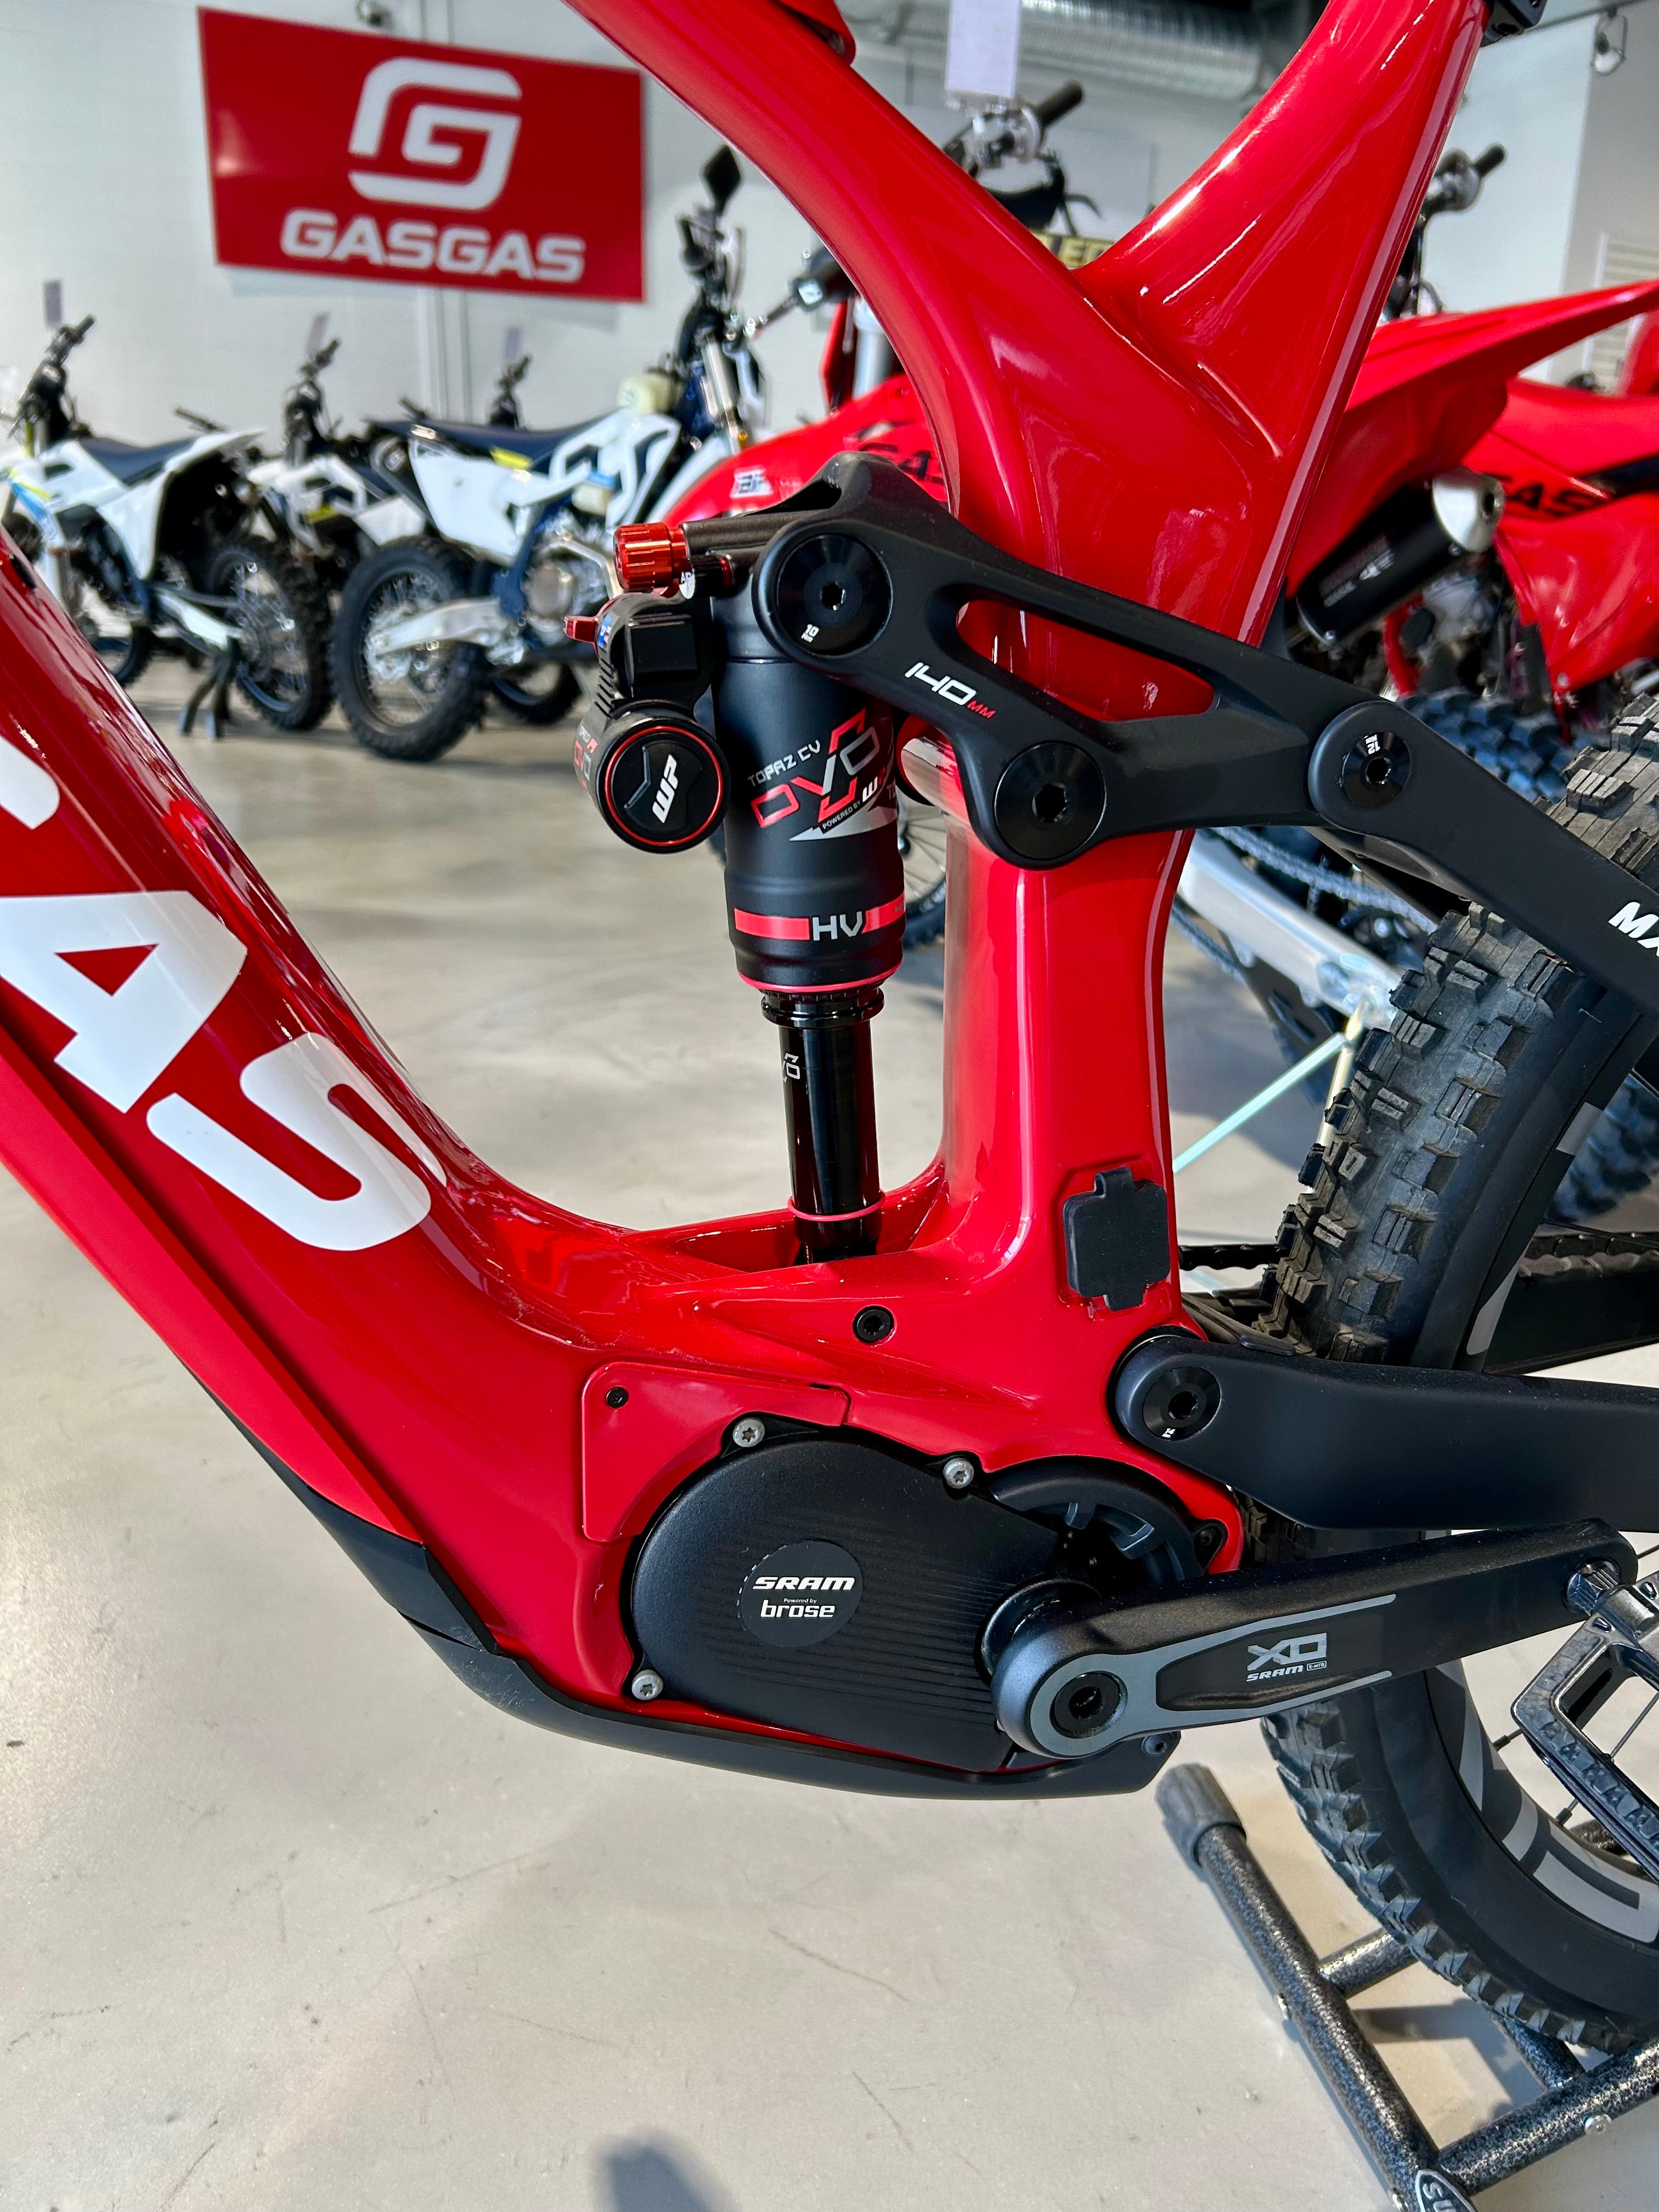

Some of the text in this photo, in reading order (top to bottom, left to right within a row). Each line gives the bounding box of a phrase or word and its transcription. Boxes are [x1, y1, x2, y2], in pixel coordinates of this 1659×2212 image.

[280, 208, 586, 283] GASGAS
[804, 624, 819, 637] 10
[1367, 741, 1381, 755] 12
[748, 740, 821, 787] TOPAZ CV
[652, 753, 679, 823] WP
[822, 806, 853, 830] POWERED
[853, 799, 861, 811] BY
[812, 911, 863, 941] HV
[752, 1576, 855, 1590] SRAM
[760, 1599, 836, 1618] brose
[1246, 1664, 1304, 1682] SRAM
